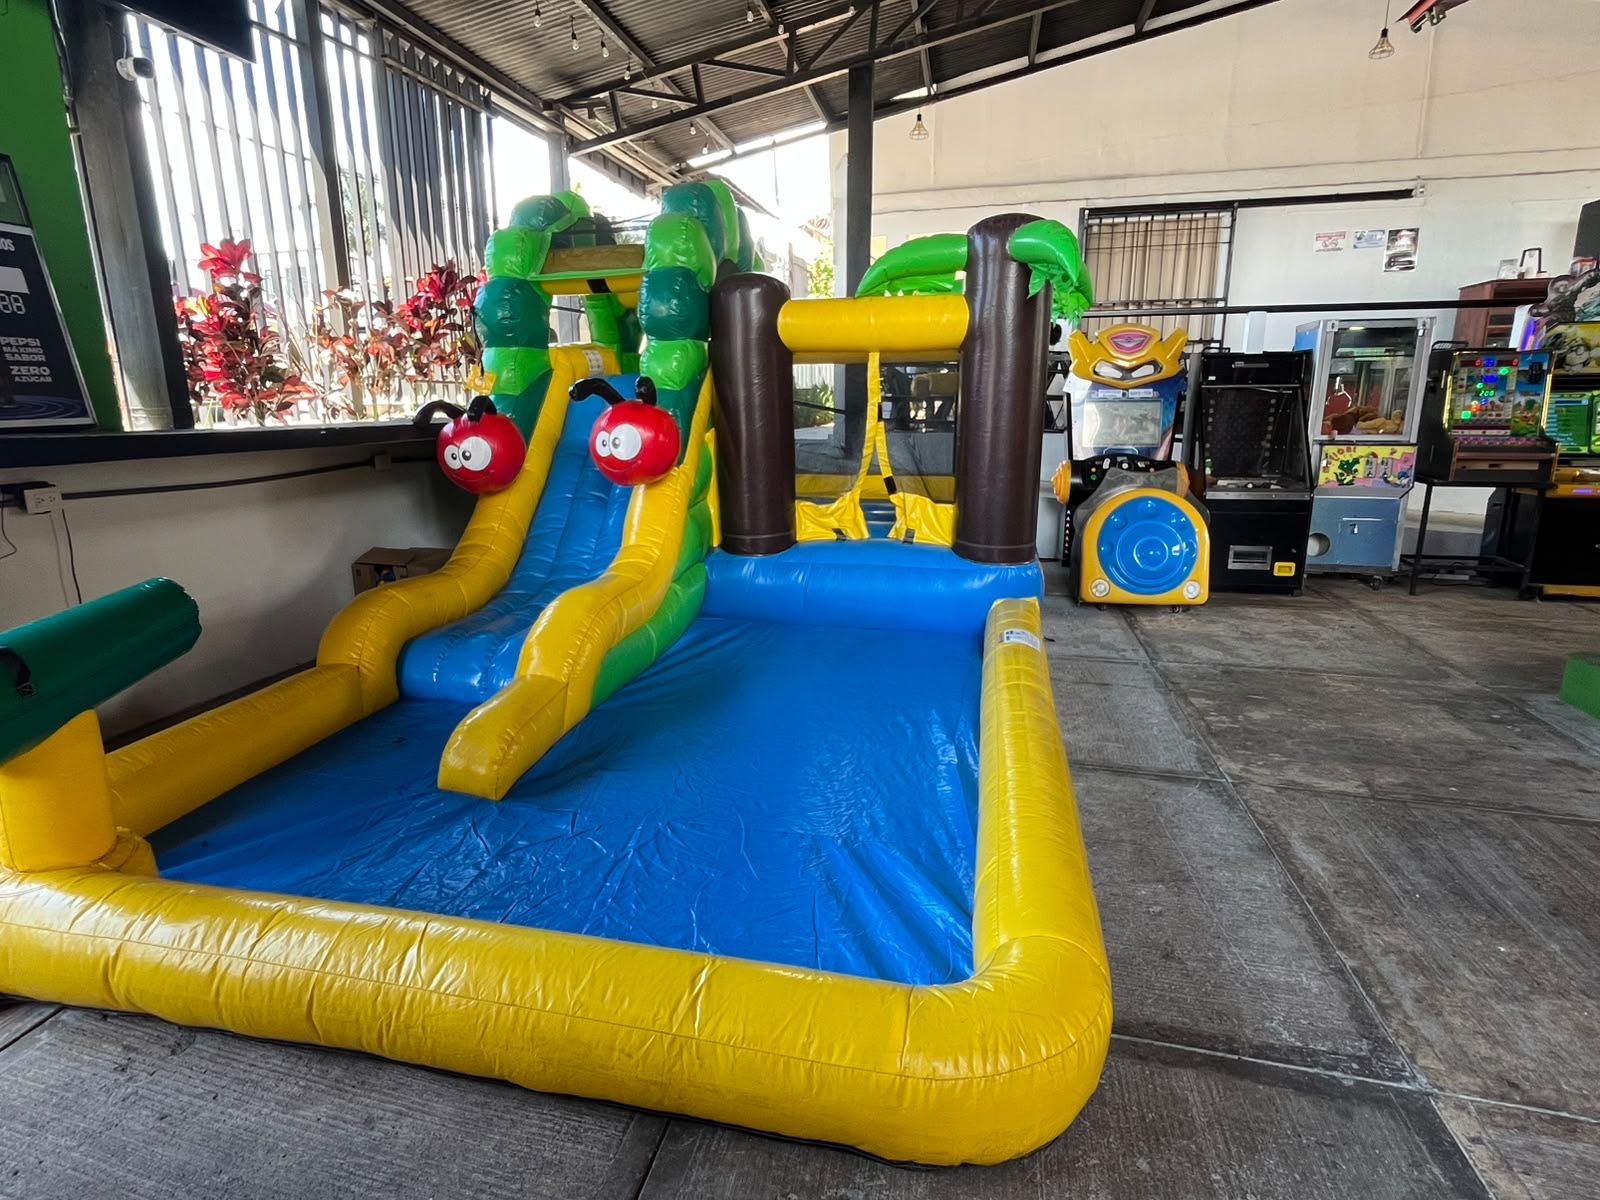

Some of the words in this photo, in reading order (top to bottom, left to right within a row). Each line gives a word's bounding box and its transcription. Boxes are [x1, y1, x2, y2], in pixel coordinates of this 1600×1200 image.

[0, 237, 15, 252] OS
[0, 336, 41, 347] PEPSI
[4, 353, 47, 362] SABOR
[9, 365, 51, 376] ZERO
